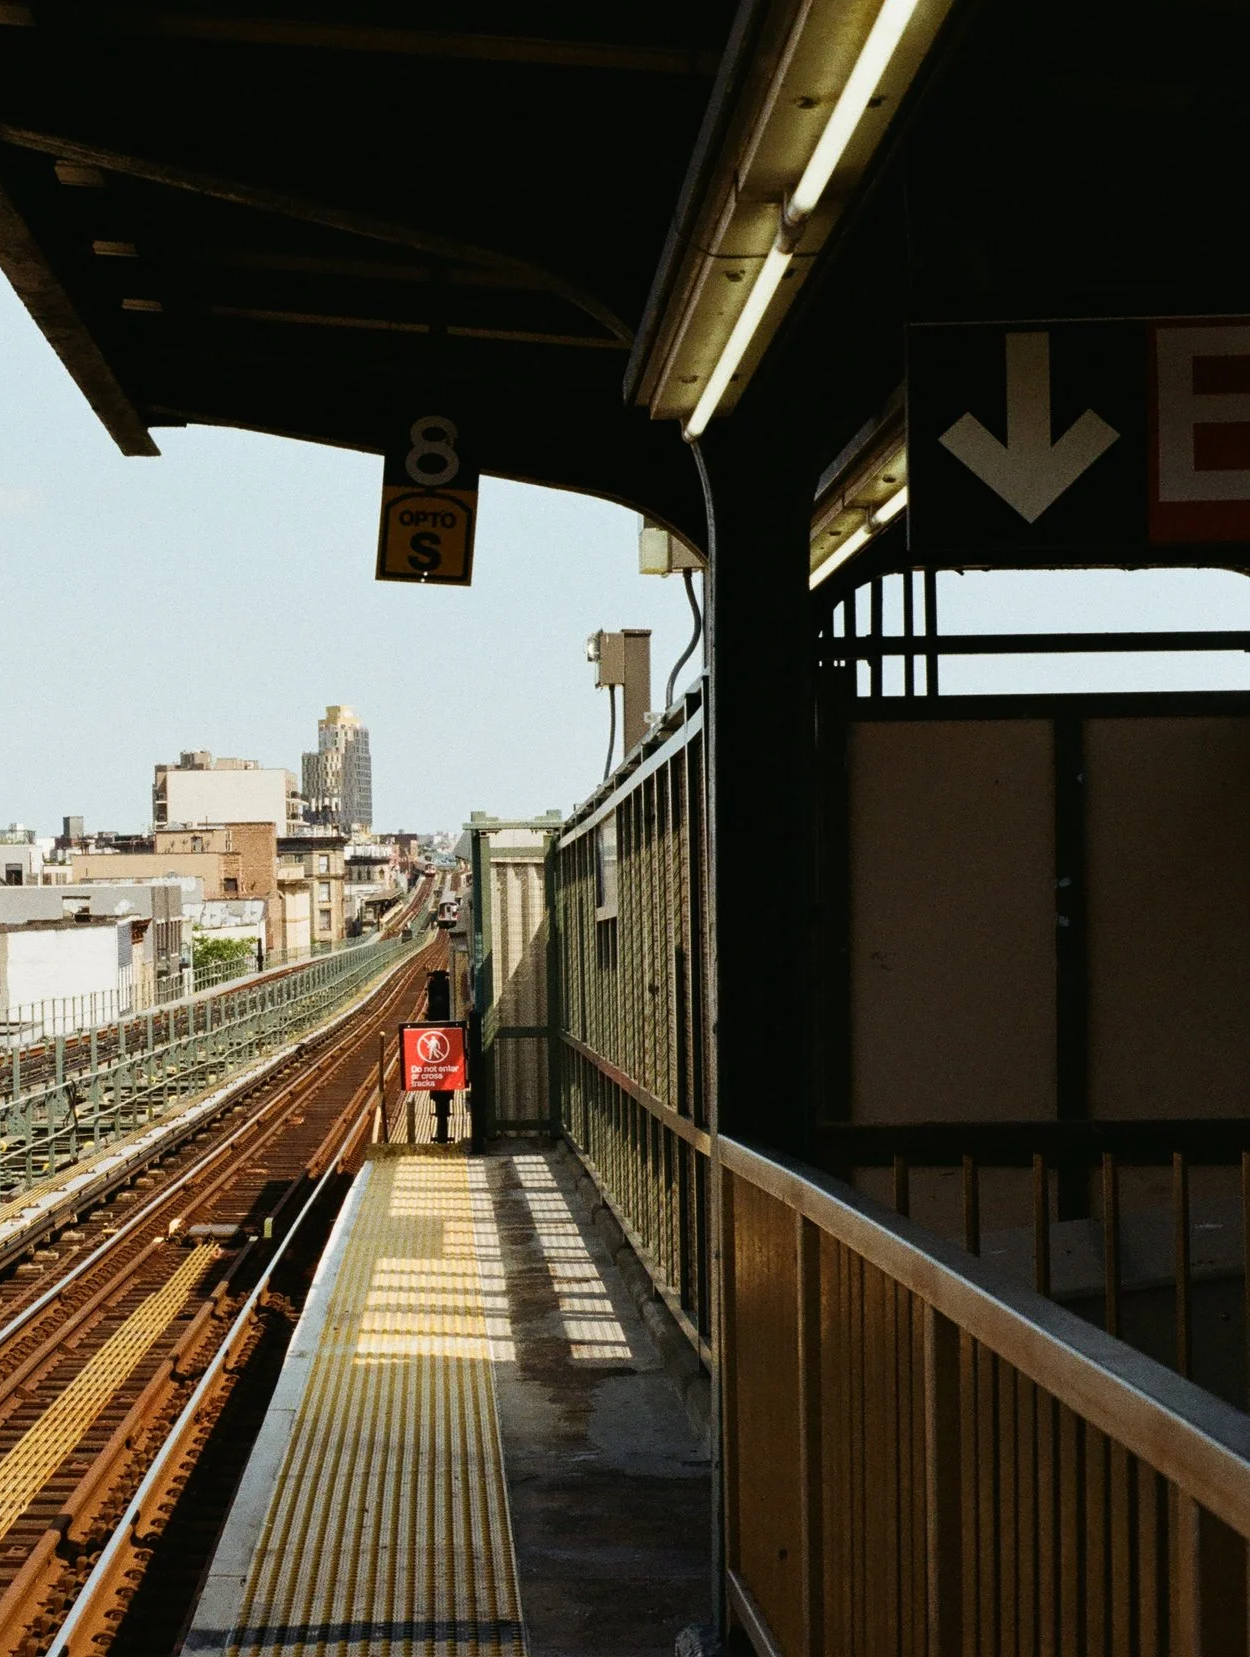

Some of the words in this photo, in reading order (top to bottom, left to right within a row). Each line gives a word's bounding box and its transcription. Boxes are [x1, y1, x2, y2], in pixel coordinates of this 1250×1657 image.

[406, 415, 459, 486] 8
[400, 509, 456, 529] OPTO
[408, 532, 441, 571] S
[411, 1065, 422, 1073] Do
[438, 1065, 459, 1073] enter
